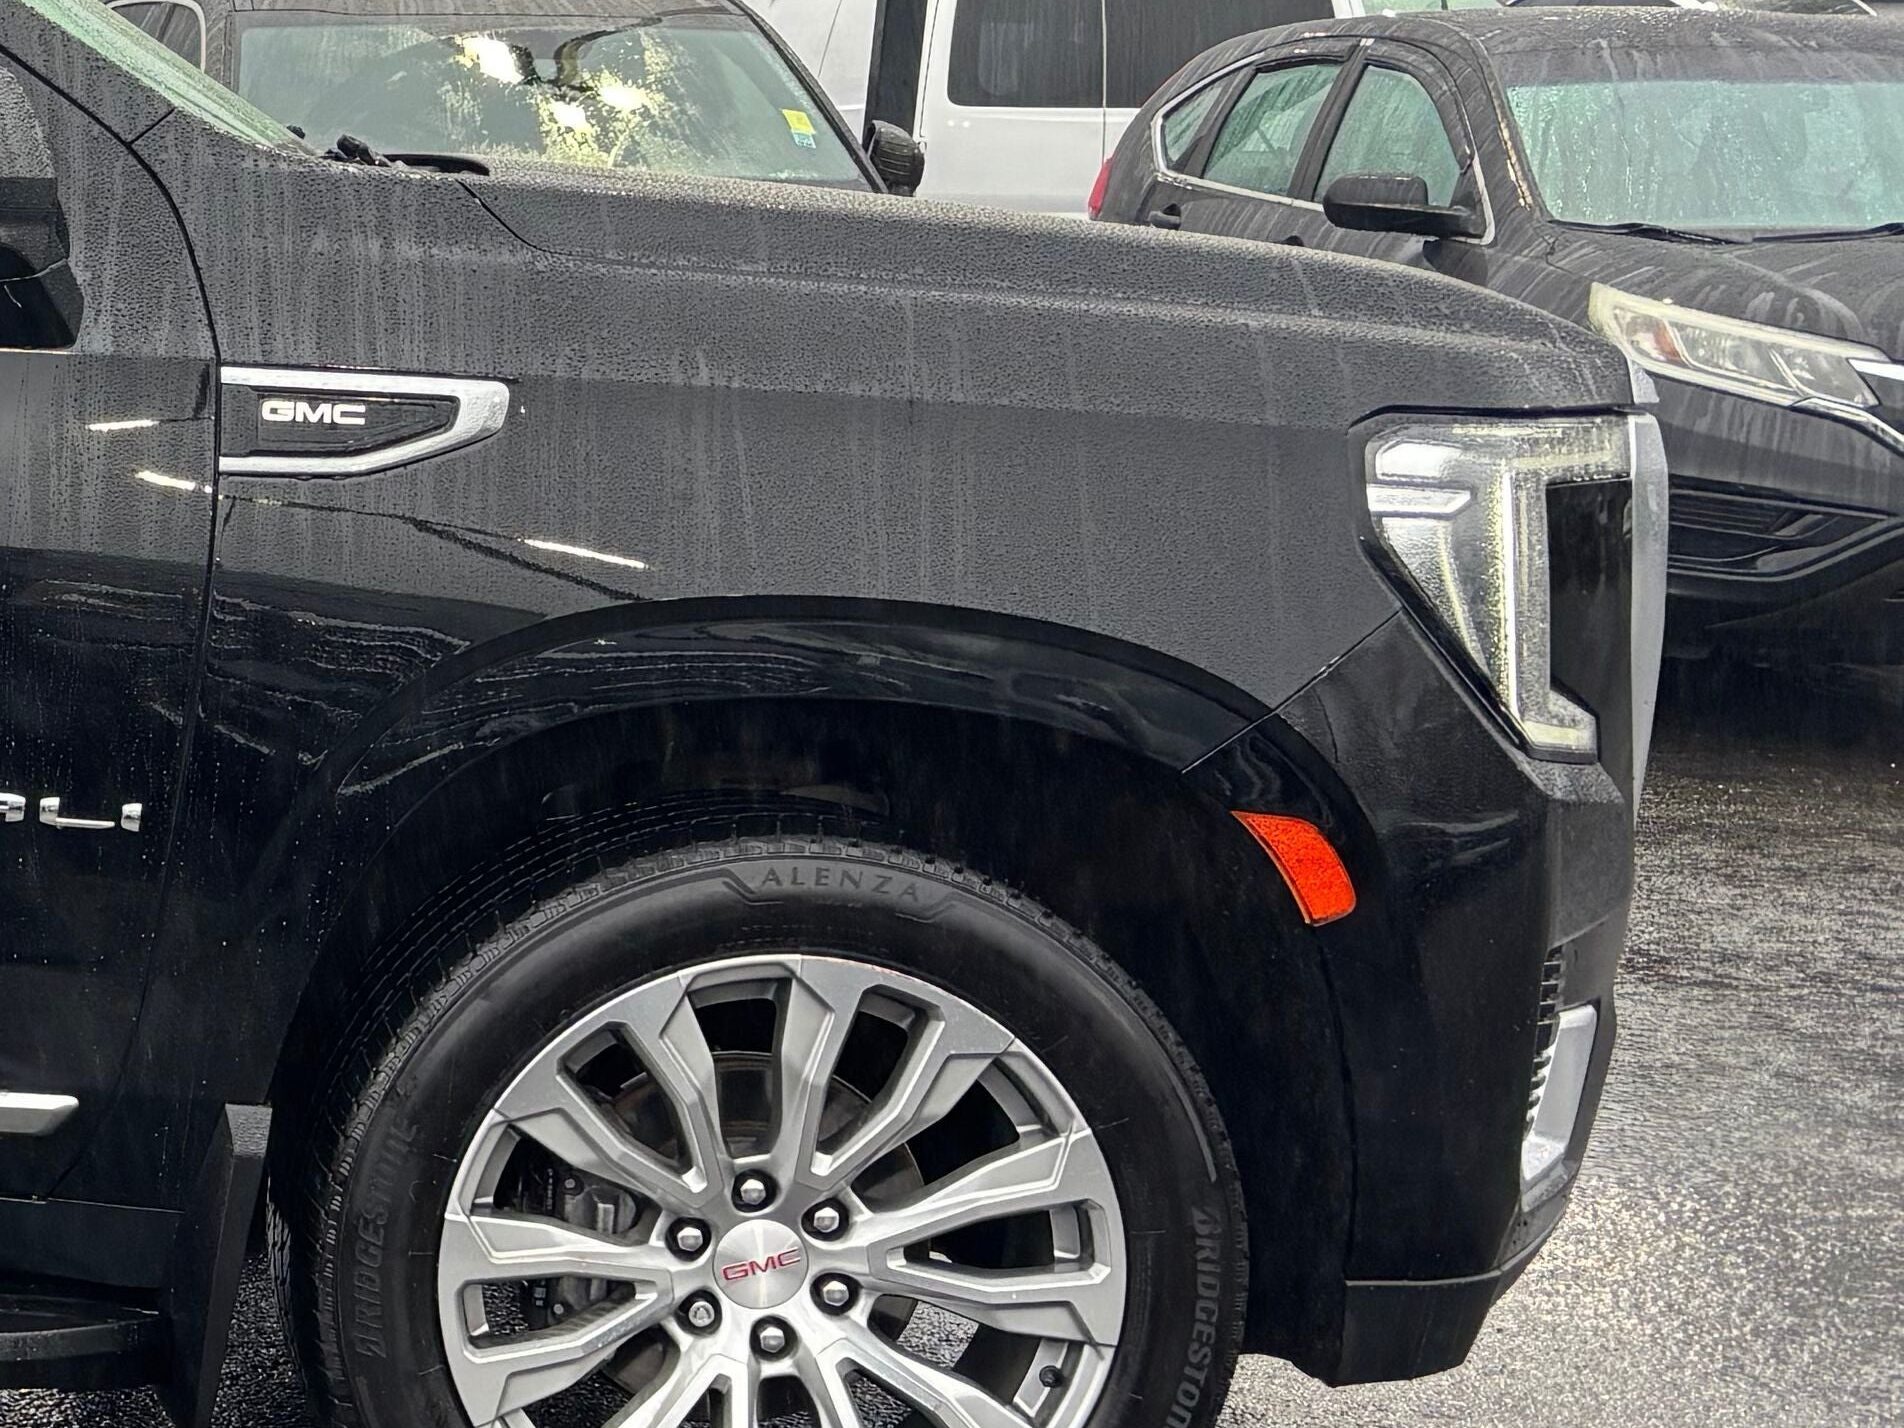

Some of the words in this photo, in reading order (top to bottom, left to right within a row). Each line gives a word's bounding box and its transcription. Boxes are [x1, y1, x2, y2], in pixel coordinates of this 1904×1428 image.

[261, 400, 366, 425] GMC
[761, 866, 920, 903] ALENZA
[721, 1246, 801, 1281] GMC
